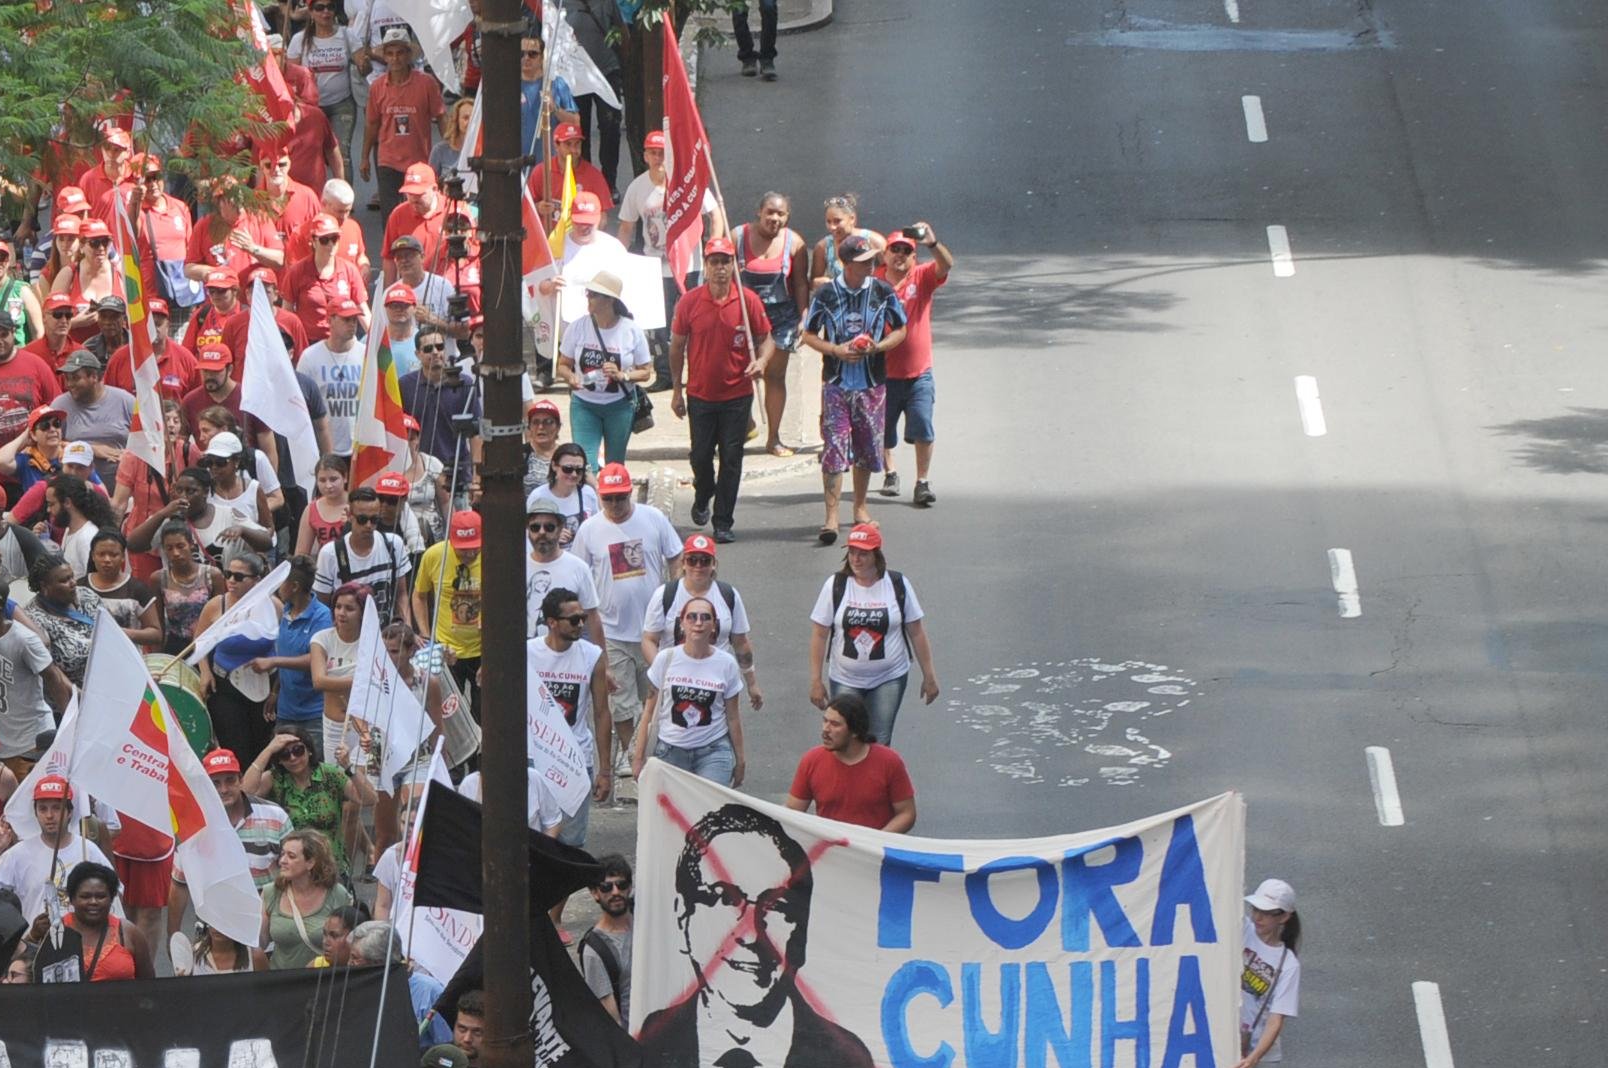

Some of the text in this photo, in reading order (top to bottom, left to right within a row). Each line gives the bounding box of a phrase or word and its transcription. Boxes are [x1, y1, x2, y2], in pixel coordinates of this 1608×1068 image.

[326, 382, 358, 400] AND
[559, 672, 589, 683] CUNHA
[877, 814, 1218, 952] FORA
